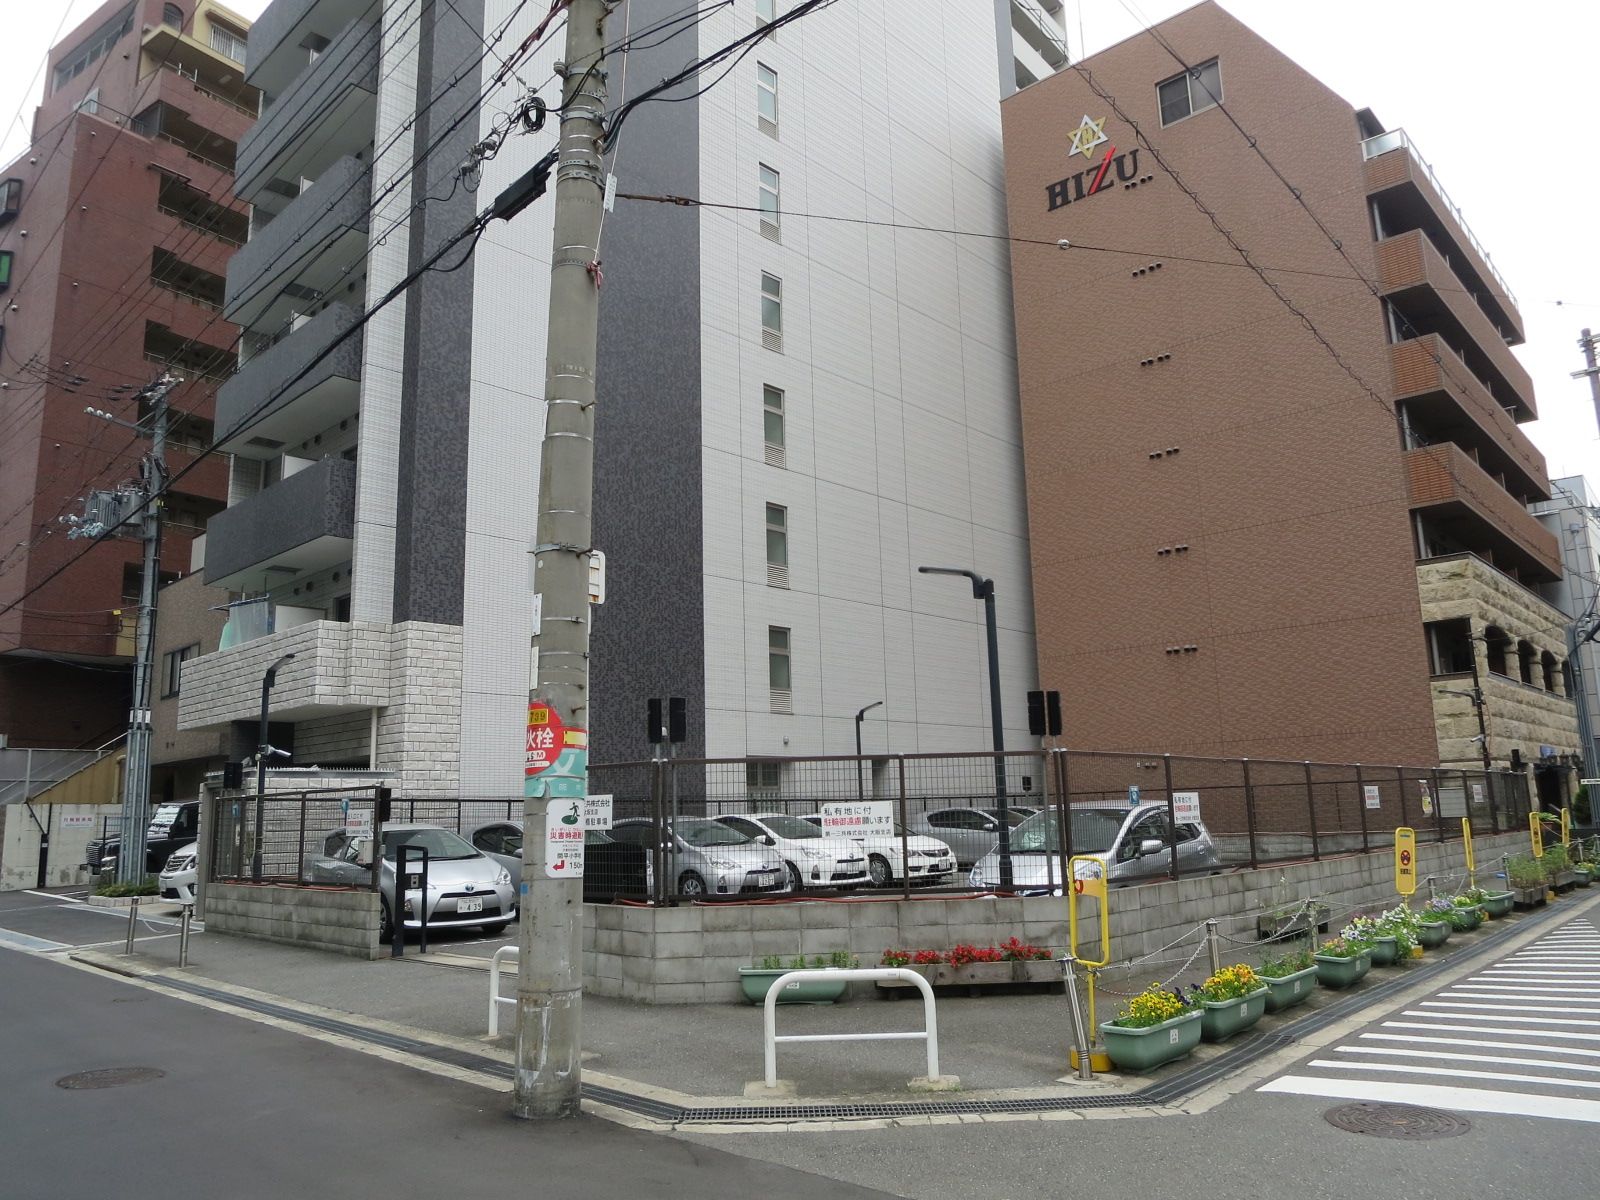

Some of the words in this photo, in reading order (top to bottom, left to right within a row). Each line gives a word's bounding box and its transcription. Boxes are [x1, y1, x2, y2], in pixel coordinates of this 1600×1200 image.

[1045, 145, 1139, 212] HIZU
[824, 806, 871, 816] 私有地に付
